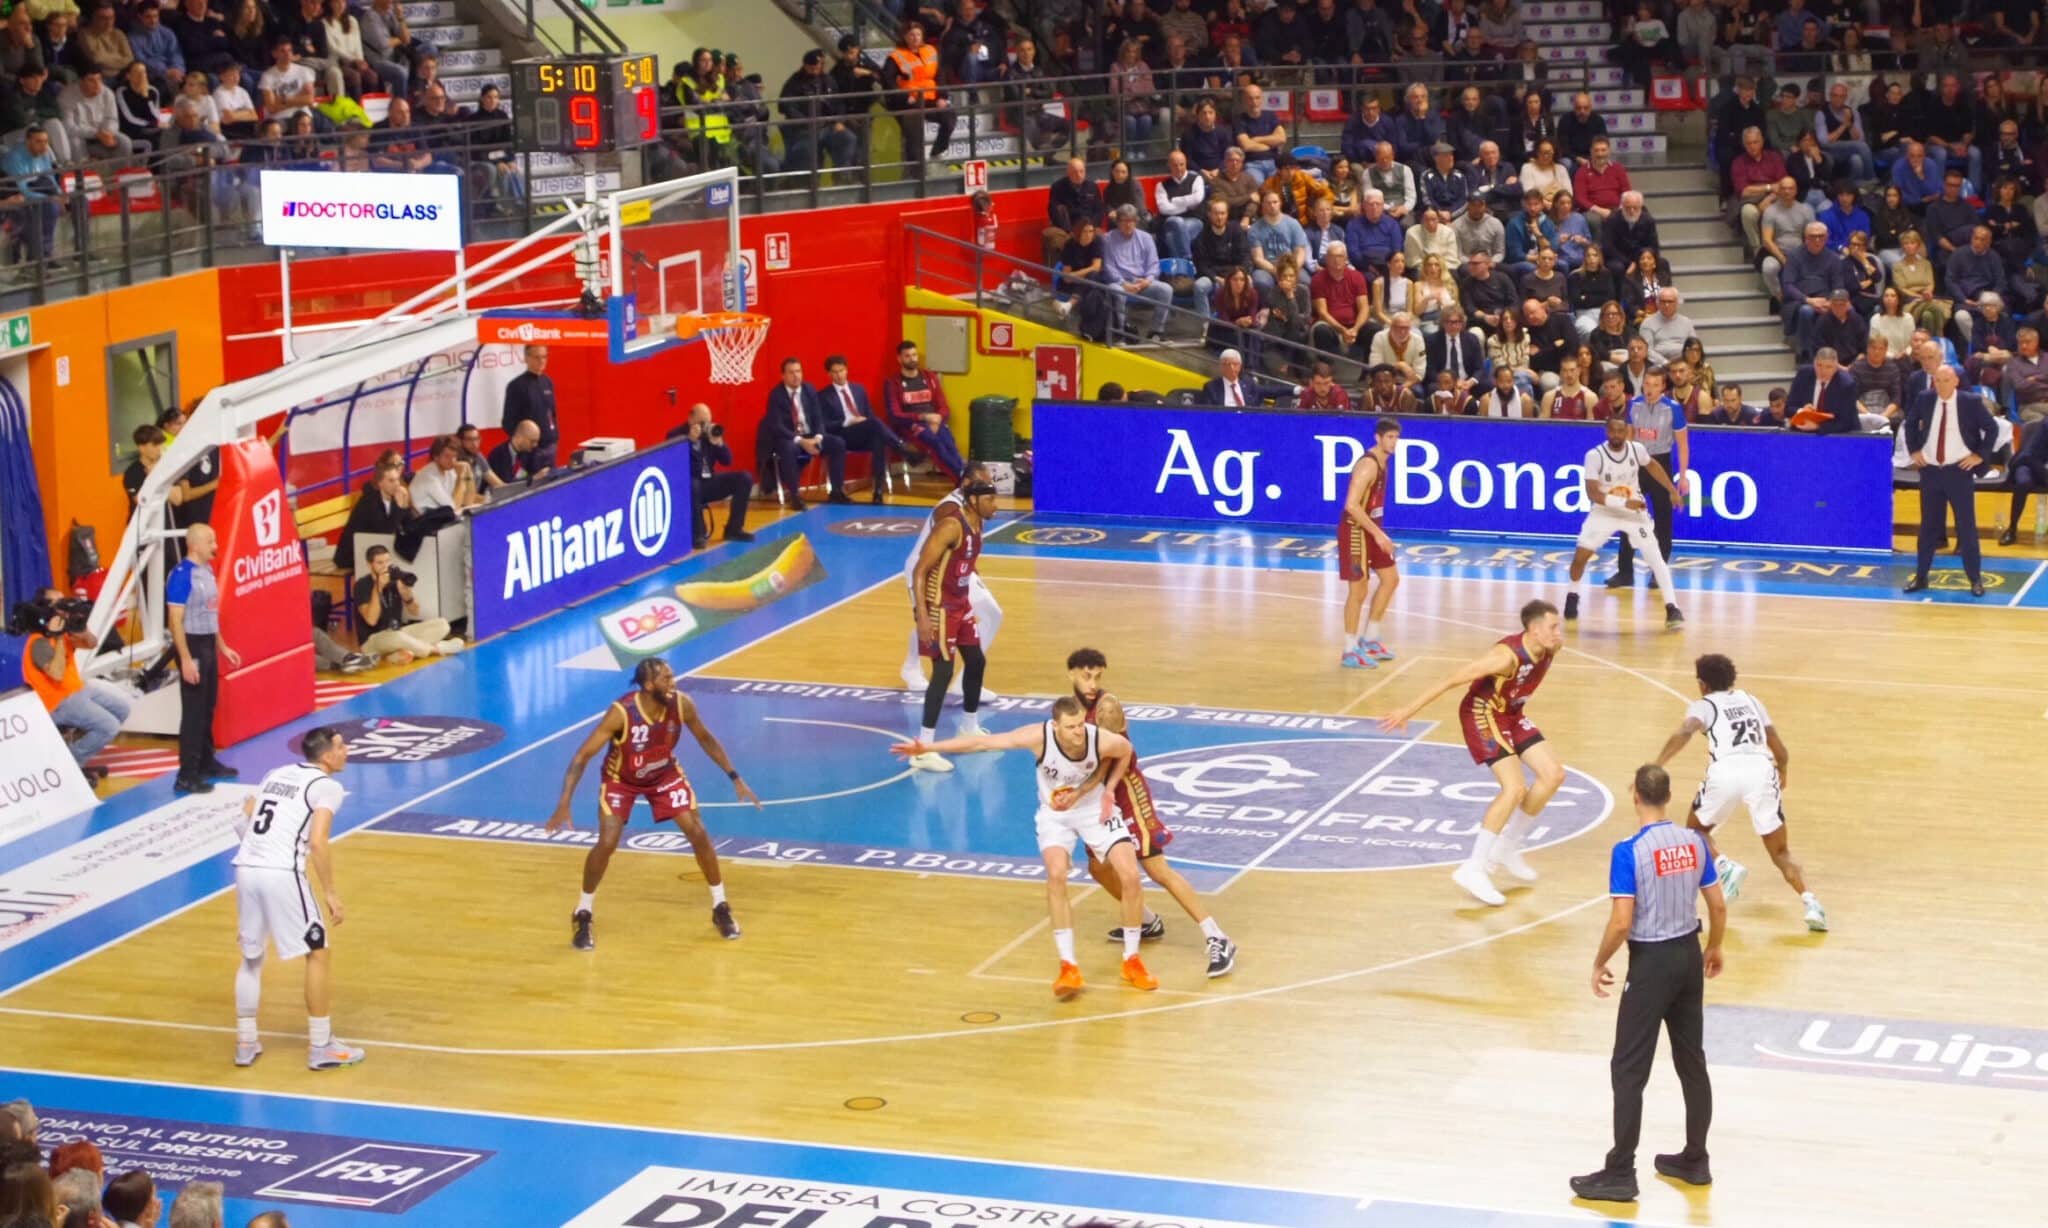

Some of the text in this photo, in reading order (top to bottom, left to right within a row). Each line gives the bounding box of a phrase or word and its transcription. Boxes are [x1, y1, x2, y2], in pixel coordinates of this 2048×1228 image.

[540, 65, 596, 92] 5:10
[622, 57, 652, 88] 5:10
[570, 96, 600, 147] 9
[637, 88, 657, 140] 9
[297, 201, 438, 221] DOCTORGLASS
[1155, 428, 1282, 517] Ag.
[1394, 437, 1758, 522] Bonano
[1133, 530, 1462, 560] ITALIO
[1638, 527, 1647, 538] 8
[233, 539, 303, 584] CiviBank
[503, 508, 625, 600] Allianz
[618, 602, 677, 638] Dole
[0, 713, 28, 742] ZO
[631, 724, 649, 743] 22
[1186, 708, 1357, 731] Allianz
[1730, 718, 1764, 748] 23
[347, 721, 444, 759] SKY
[391, 725, 485, 762] ENERGY
[0, 768, 62, 809] UOLO
[669, 788, 690, 808] 22
[252, 799, 278, 836] 5
[1104, 816, 1123, 833] 22
[1152, 799, 1309, 824] REDI
[1318, 811, 1551, 841] FRIUI
[1163, 823, 1280, 839] GRUPPO
[1300, 834, 1462, 852] BCC ICCREA
[738, 841, 828, 861] Ag.
[1660, 845, 1693, 862] ATTAL
[96, 1136, 142, 1152] SUL
[148, 1141, 299, 1167] PRESENTE
[128, 1127, 165, 1140] AL
[171, 1130, 289, 1151] FUTURO
[118, 1158, 242, 1180] produzione
[314, 1160, 424, 1186] FISA
[677, 1176, 881, 1210] IMPRESA
